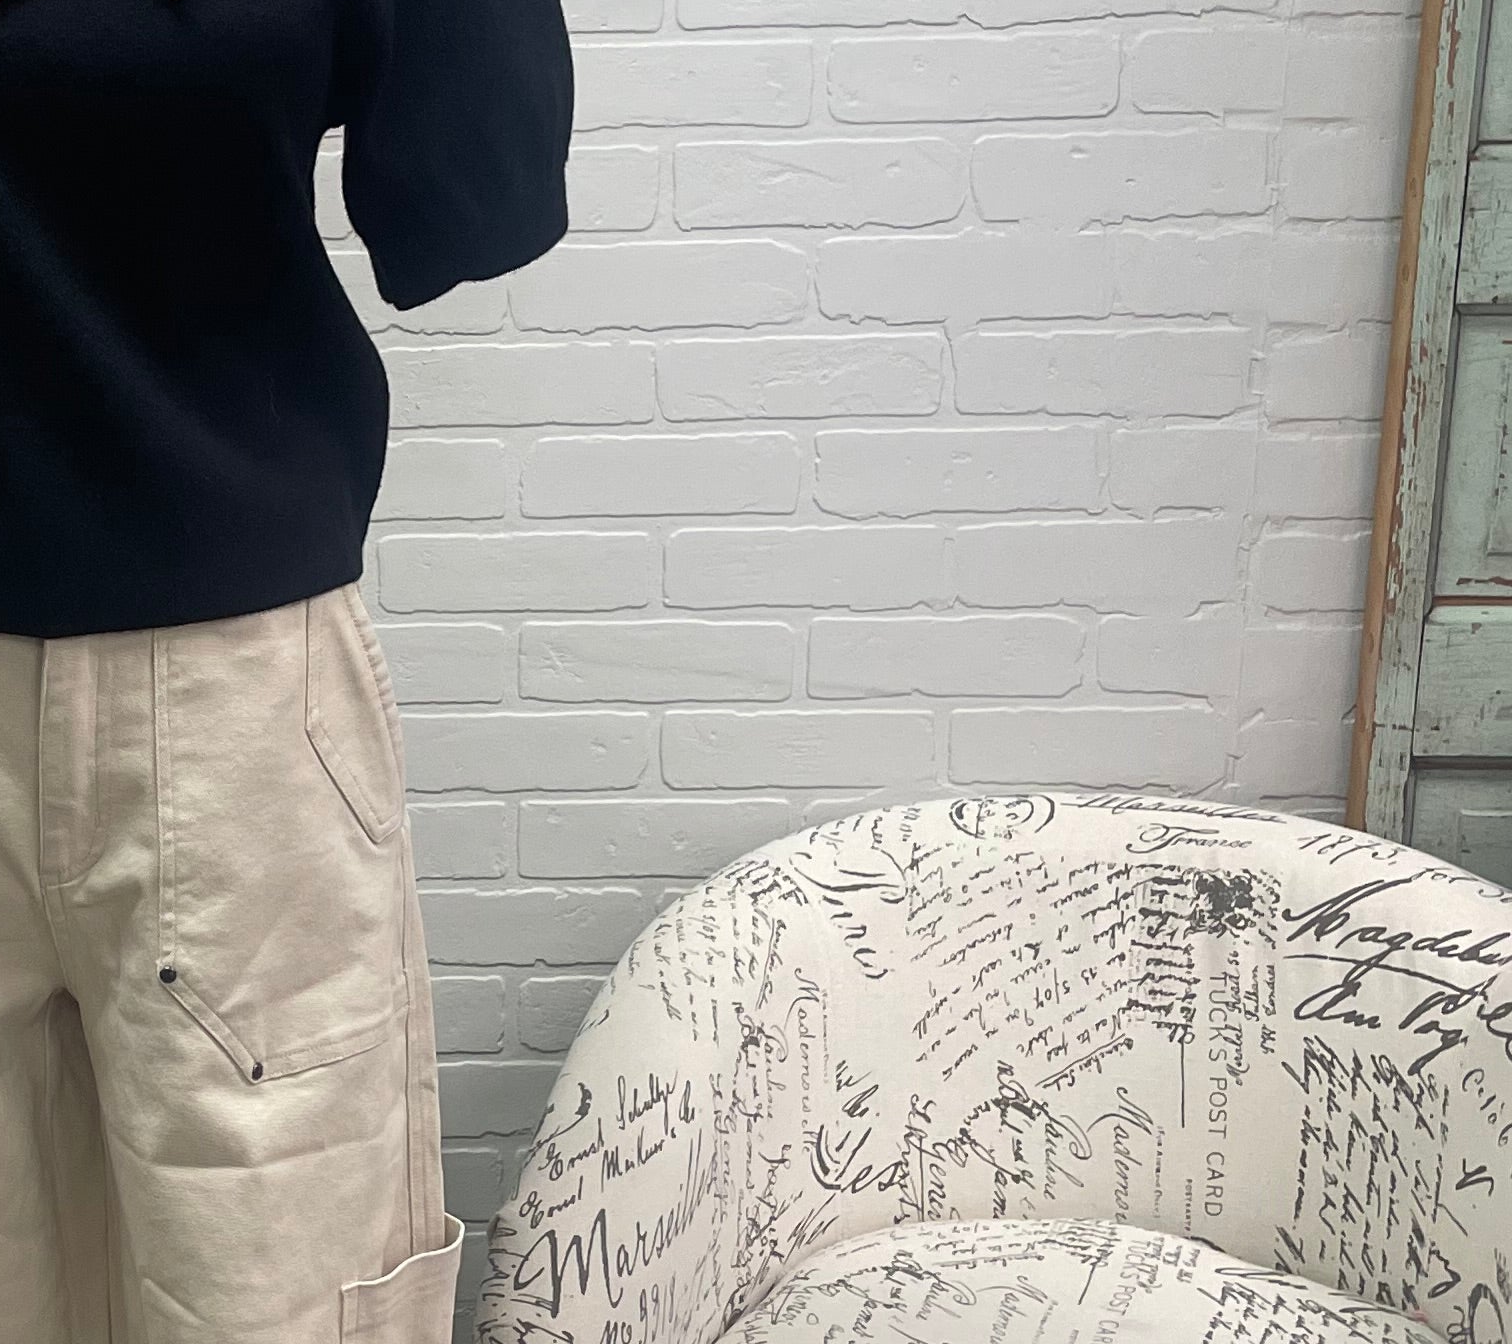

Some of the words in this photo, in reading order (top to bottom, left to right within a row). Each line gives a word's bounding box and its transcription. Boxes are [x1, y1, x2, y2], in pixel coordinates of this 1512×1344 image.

[1209, 1078, 1230, 1141] POST
[1203, 1150, 1225, 1219] CARD
[1106, 1283, 1137, 1317] POST
